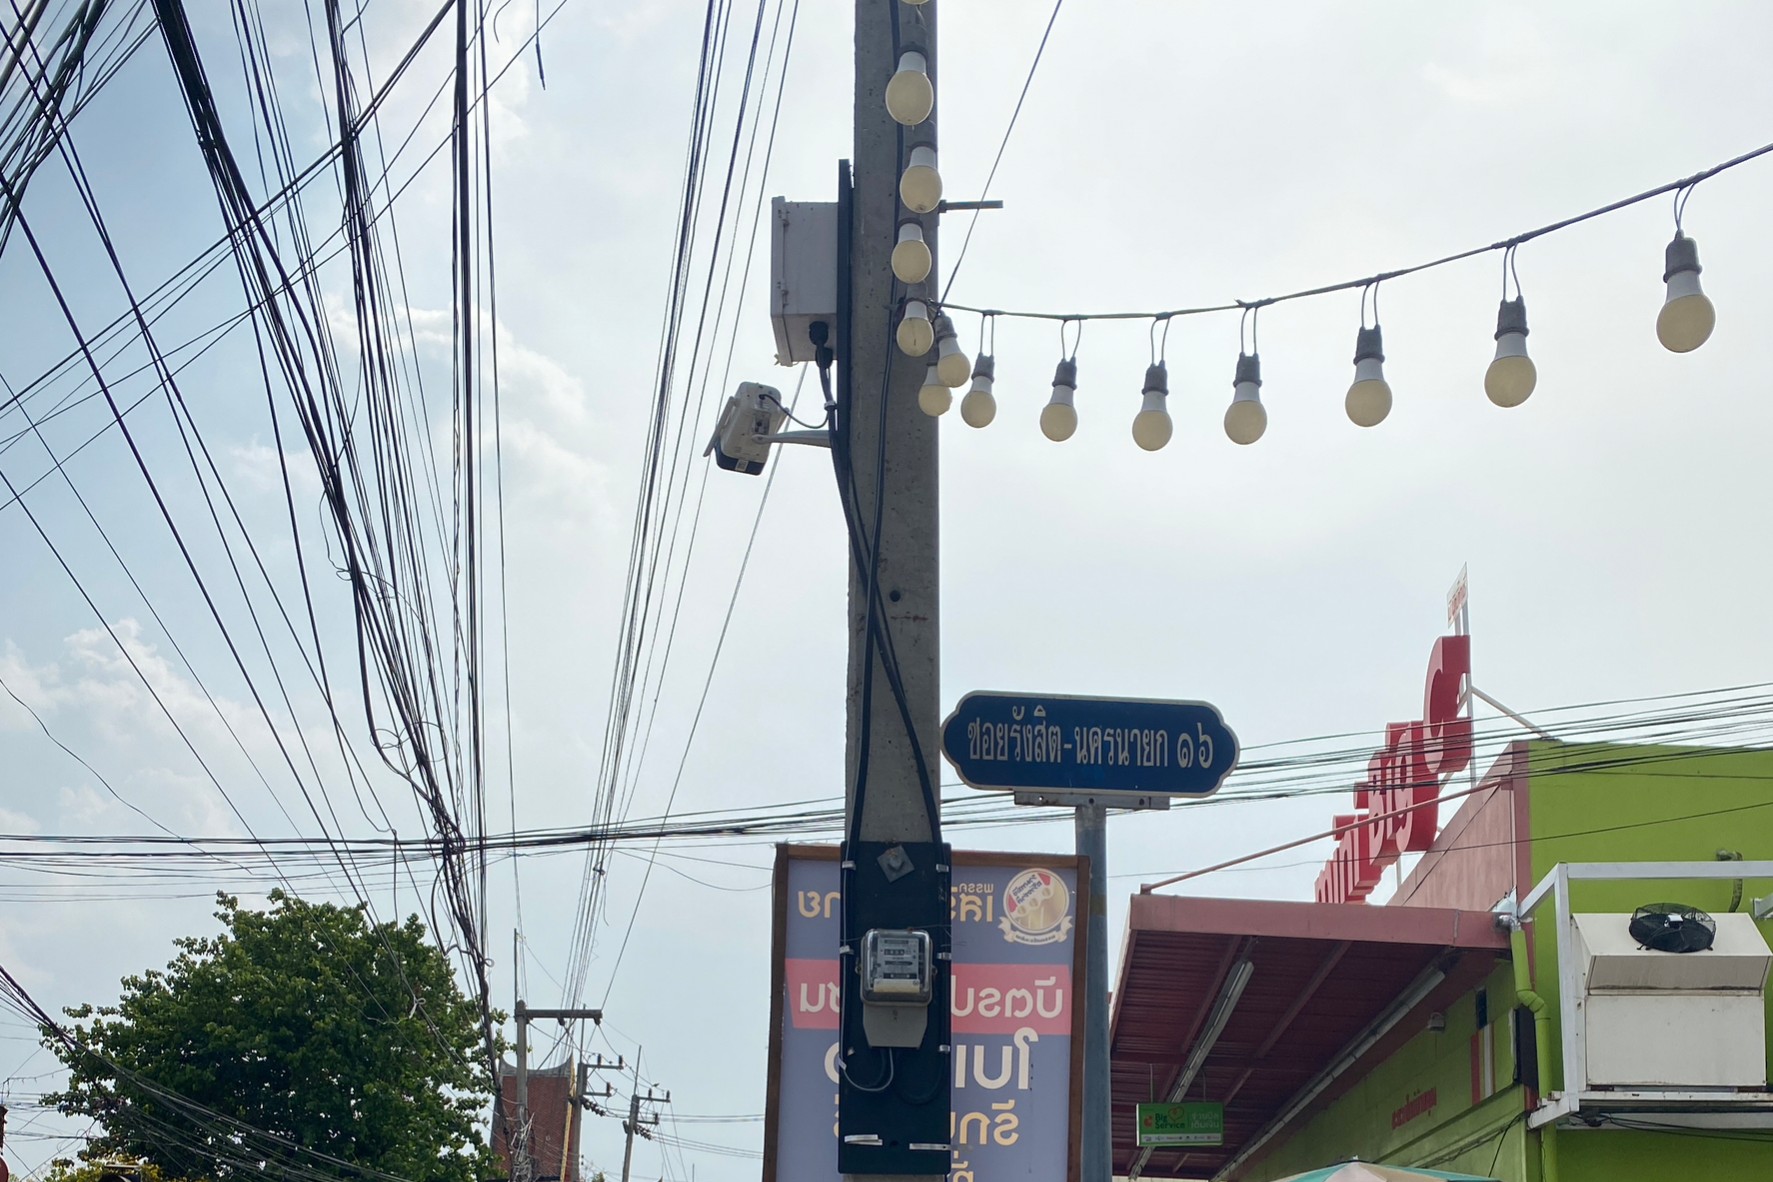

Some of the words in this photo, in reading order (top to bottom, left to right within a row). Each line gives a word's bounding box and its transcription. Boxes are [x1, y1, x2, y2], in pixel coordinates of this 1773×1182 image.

[967, 705, 1169, 767] ซอยรังสิต-นครนายก
[1176, 722, 1214, 769] ๑๖
[1367, 722, 1439, 866] Big
[1423, 635, 1472, 774] C
